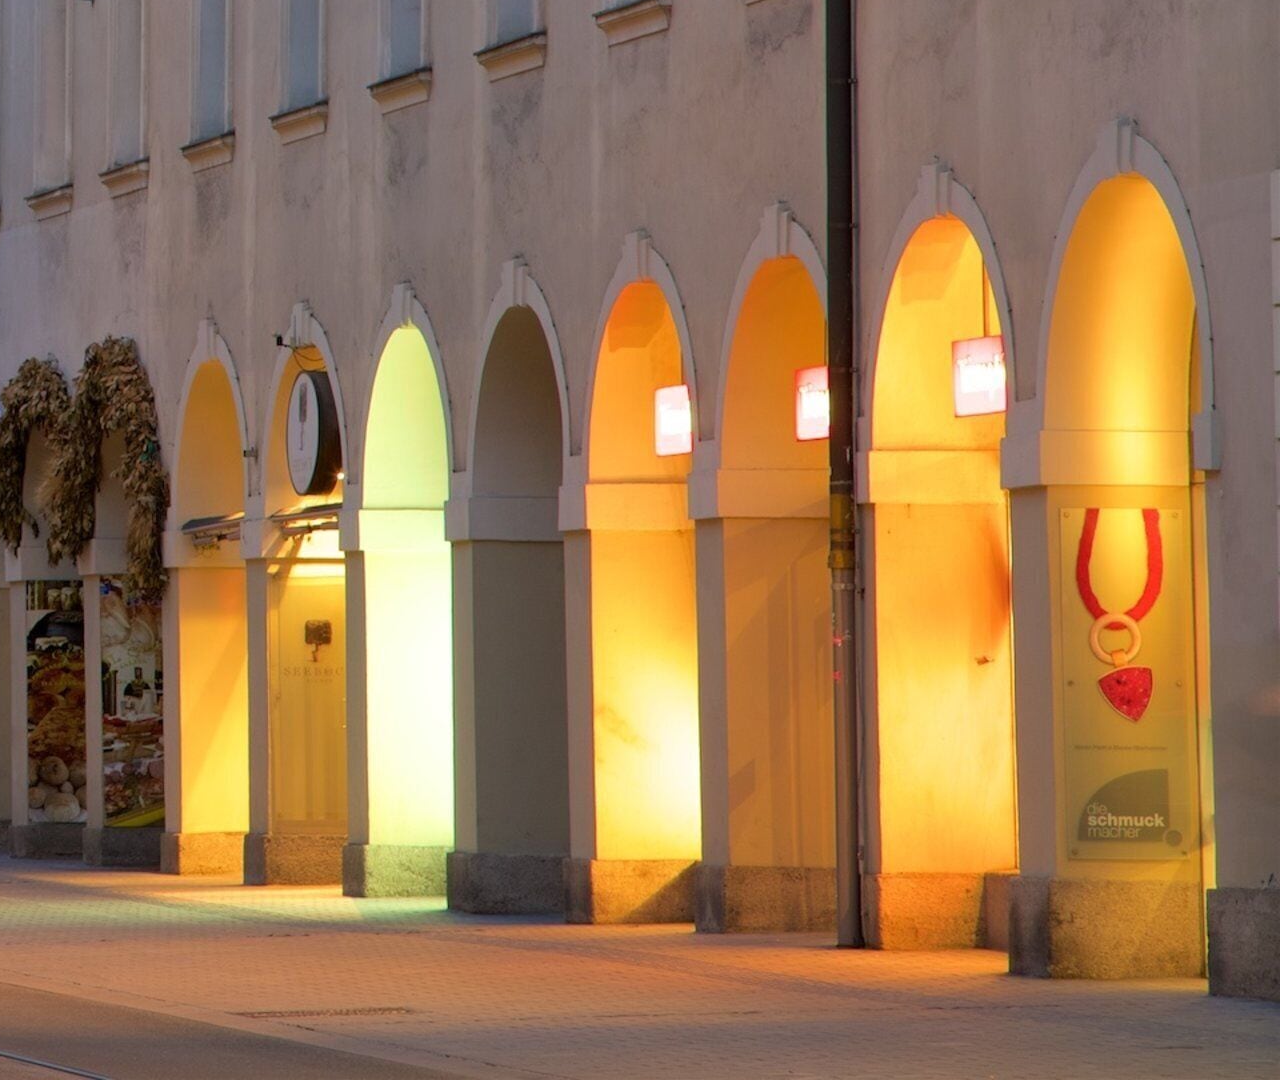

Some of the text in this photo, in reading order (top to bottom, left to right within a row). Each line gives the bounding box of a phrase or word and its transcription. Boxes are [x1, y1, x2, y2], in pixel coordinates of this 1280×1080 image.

[1087, 801, 1108, 815] die
[1087, 812, 1166, 828] schmuck
[1087, 825, 1142, 839] macher
